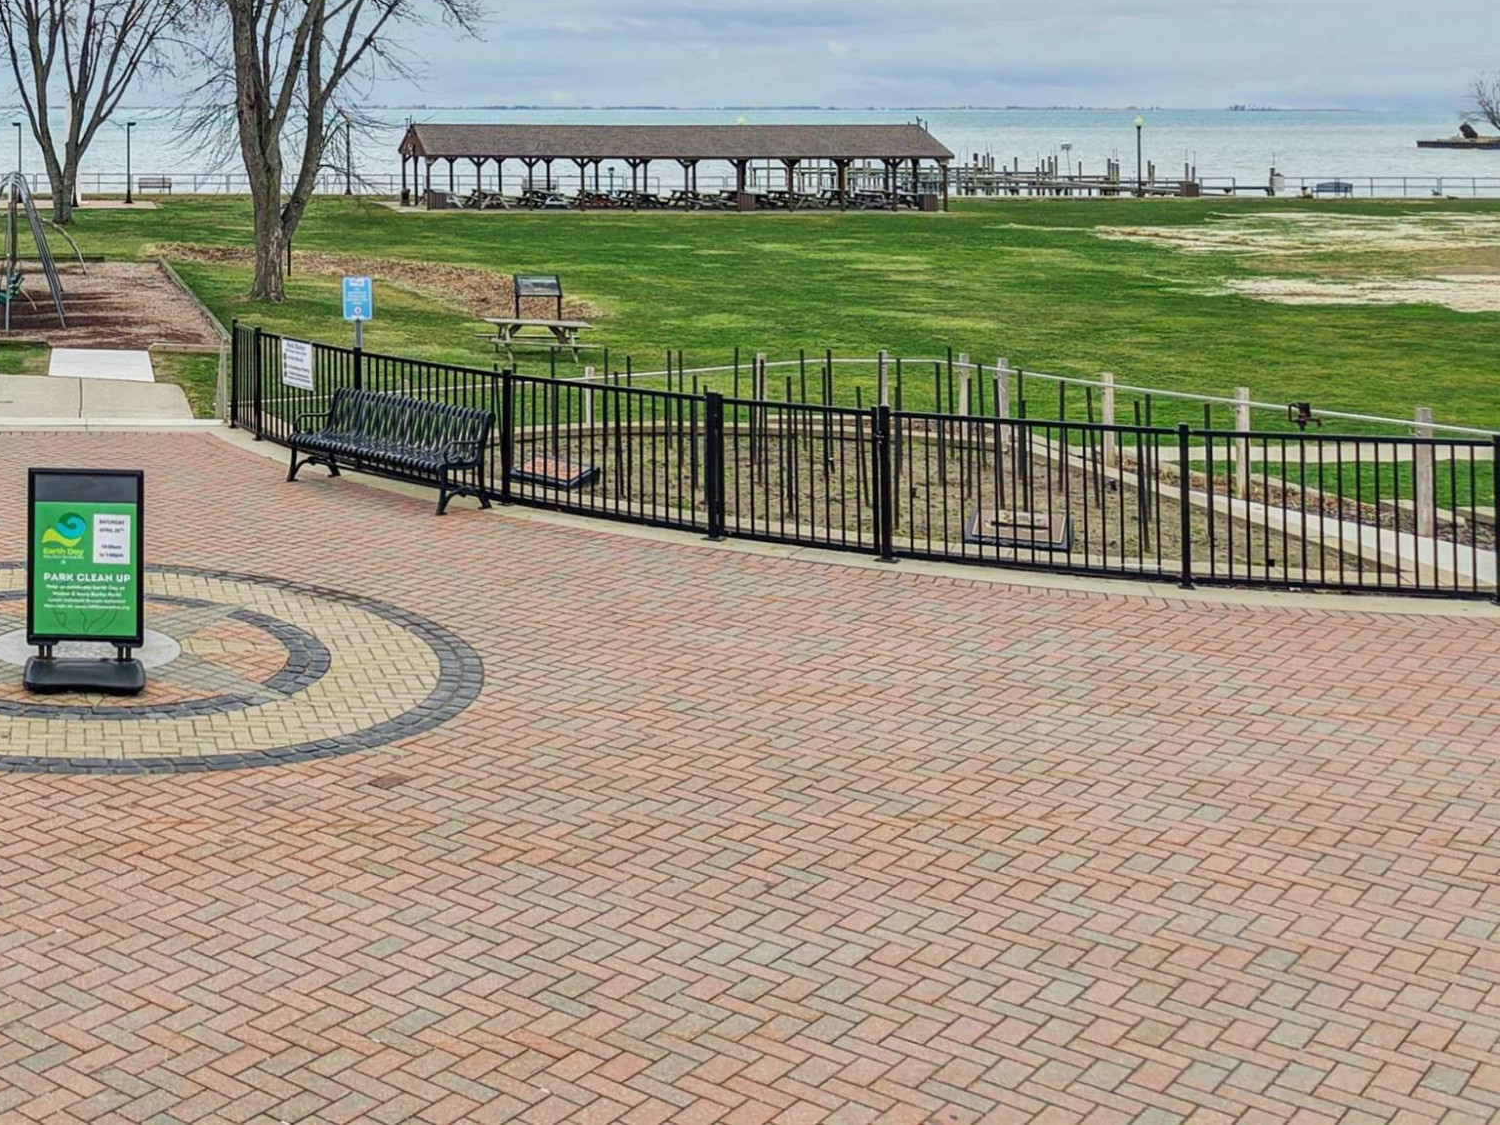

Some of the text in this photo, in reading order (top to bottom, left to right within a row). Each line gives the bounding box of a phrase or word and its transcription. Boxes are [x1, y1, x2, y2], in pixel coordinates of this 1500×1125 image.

[43, 547, 84, 556] Earth Day
[43, 572, 131, 582] PARK CLEAN UP
